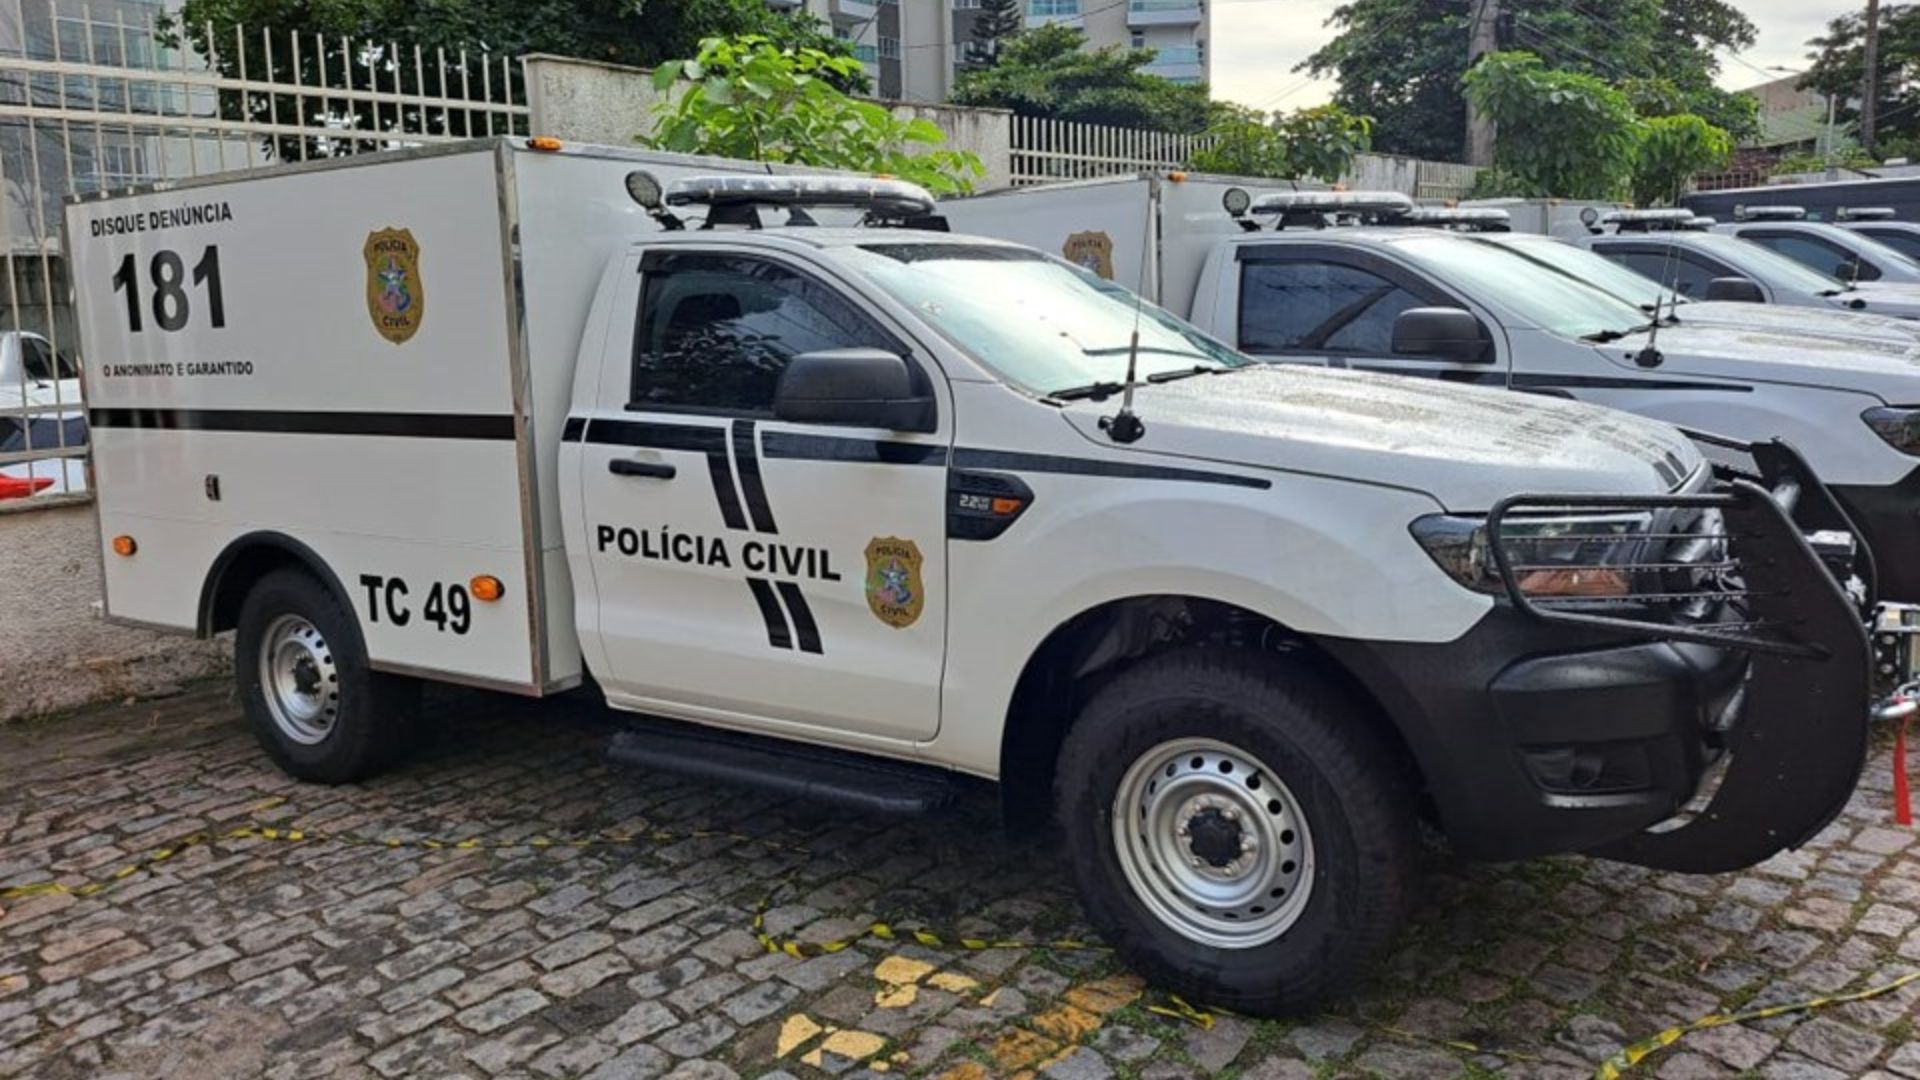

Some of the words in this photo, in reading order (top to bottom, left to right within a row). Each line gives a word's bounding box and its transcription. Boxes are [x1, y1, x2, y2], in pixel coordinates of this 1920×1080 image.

[91, 213, 146, 237] DISQUE
[150, 202, 233, 231] DENÚNCIA
[112, 244, 225, 333] 181
[103, 364, 111, 377] O
[113, 363, 174, 377] ANONIMATO
[186, 361, 253, 376] GARANTIDO
[597, 524, 732, 568] POLÍCIA
[742, 541, 841, 581] CIVIL
[359, 574, 411, 627] TC
[423, 582, 471, 635] 49
